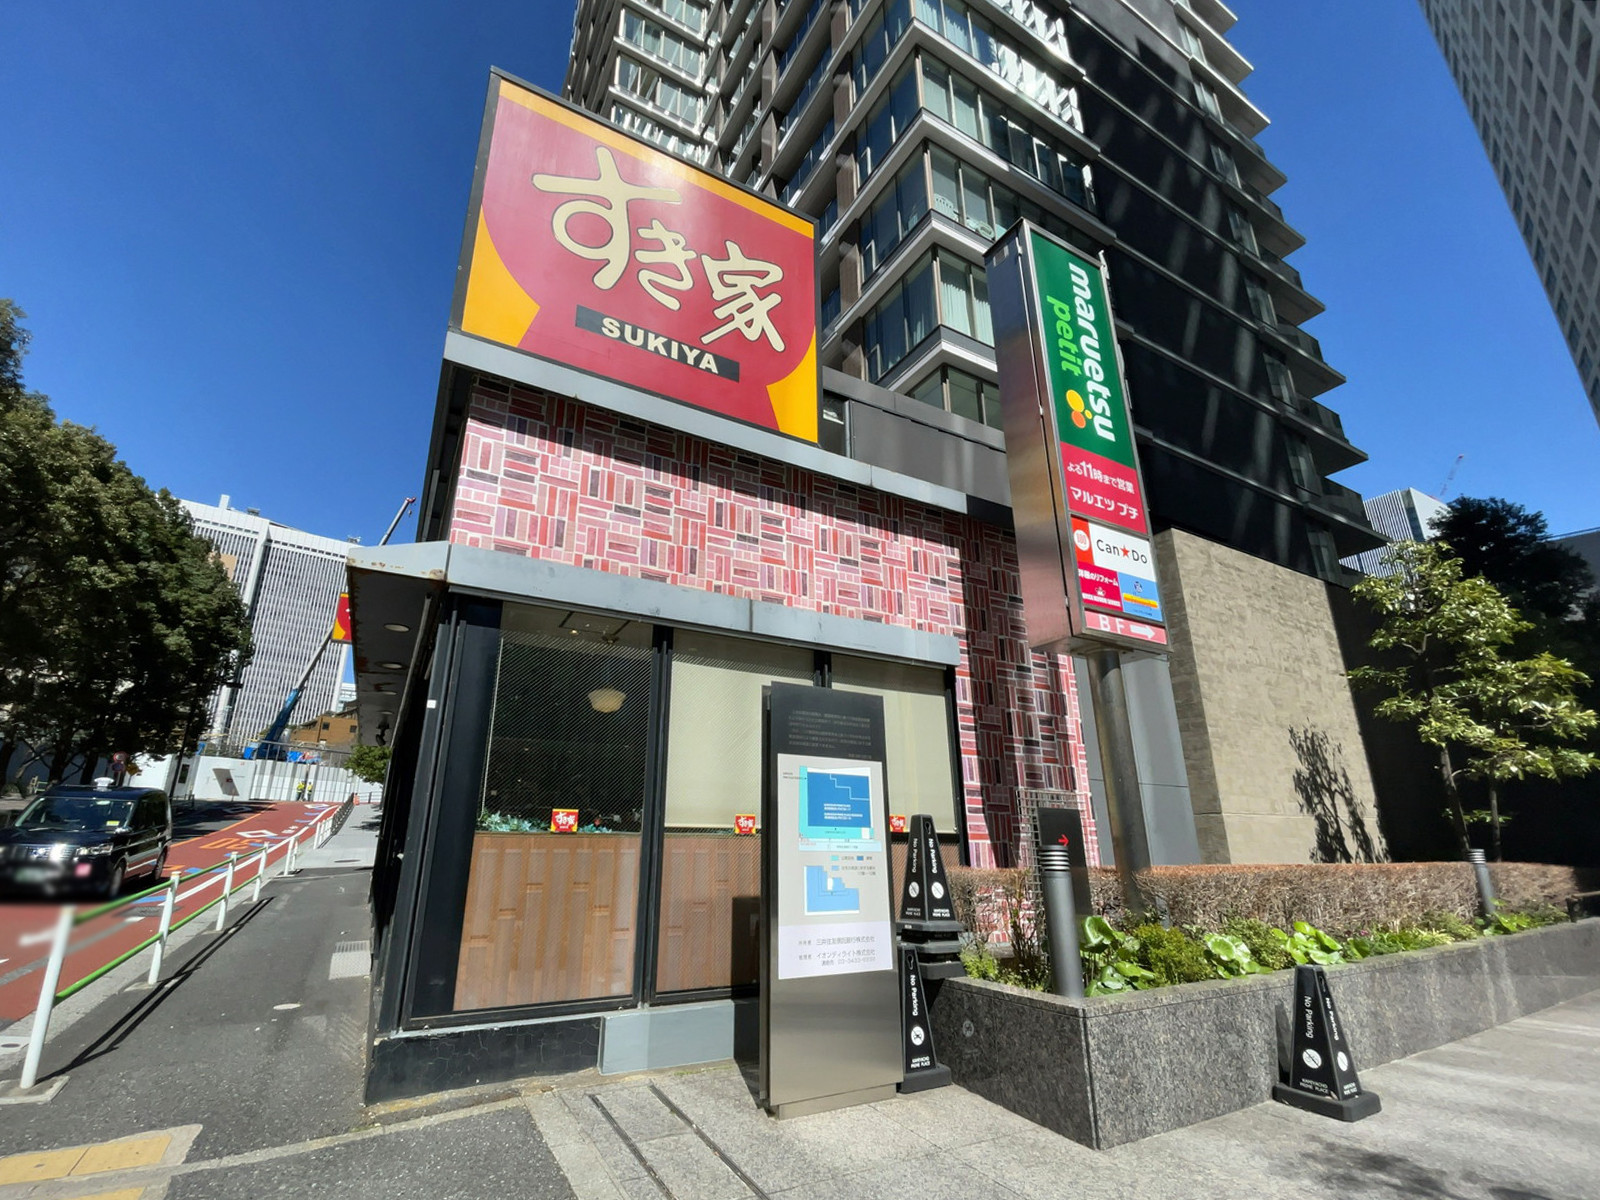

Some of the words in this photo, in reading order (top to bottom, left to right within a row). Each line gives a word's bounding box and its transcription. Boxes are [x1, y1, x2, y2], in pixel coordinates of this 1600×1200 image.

[531, 146, 786, 353] すき家
[601, 317, 719, 374] SUKIYA
[1047, 295, 1082, 376] petit
[1069, 262, 1115, 442] maruetsu
[1067, 461, 1135, 494] よる11時まで営業
[1070, 486, 1116, 511] マルエツ
[1117, 502, 1139, 519] プチ
[928, 838, 934, 848] No
[930, 848, 938, 874] Parking
[910, 974, 916, 986] No
[911, 986, 919, 1017] Parking
[1304, 995, 1311, 1007] No
[1305, 1006, 1315, 1039] Parking
[1328, 1010, 1339, 1041] Parking
